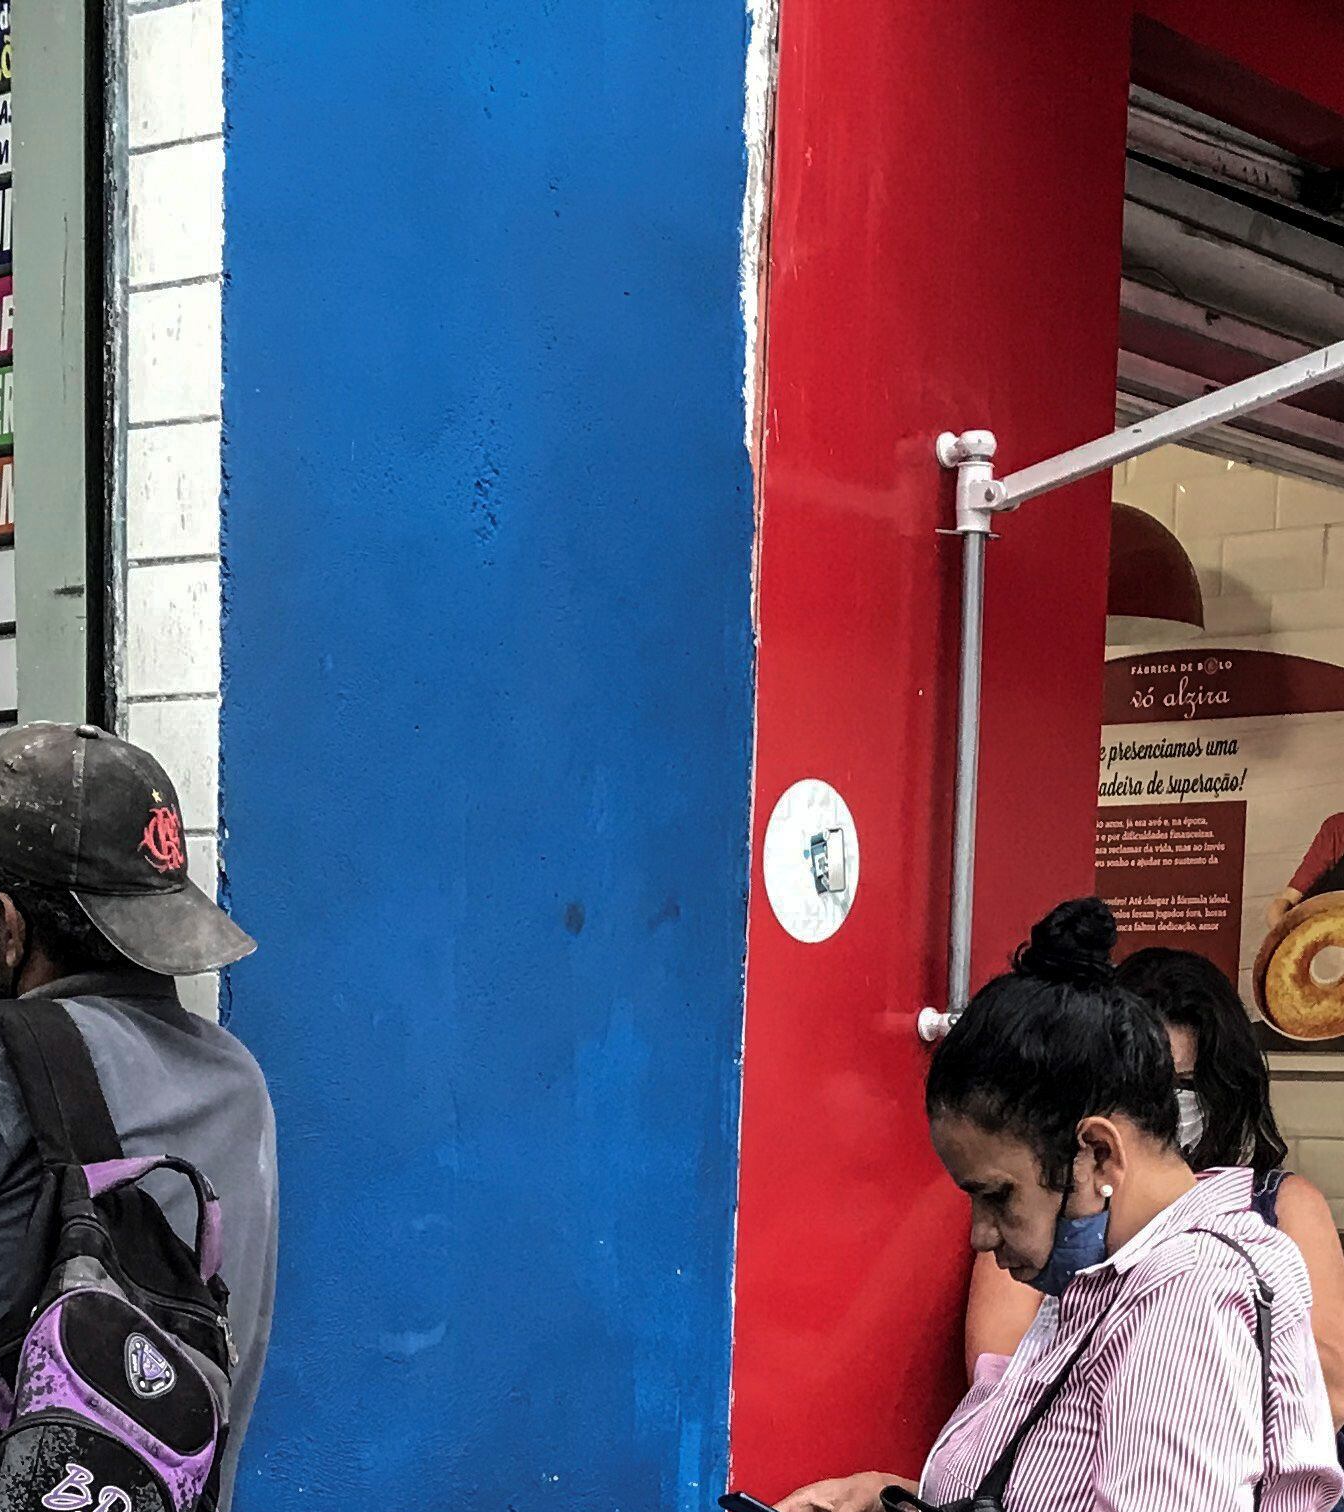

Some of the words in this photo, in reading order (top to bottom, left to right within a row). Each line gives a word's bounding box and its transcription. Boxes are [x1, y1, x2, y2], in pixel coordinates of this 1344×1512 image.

[1180, 662, 1193, 672] DE
[1130, 687, 1155, 708] vó
[1163, 675, 1230, 719] alzira
[1107, 737, 1204, 770] presenciamos
[1206, 739, 1239, 756] uma
[1098, 771, 1144, 796] adeira
[1147, 770, 1164, 795] de
[1166, 767, 1248, 803] superação!
